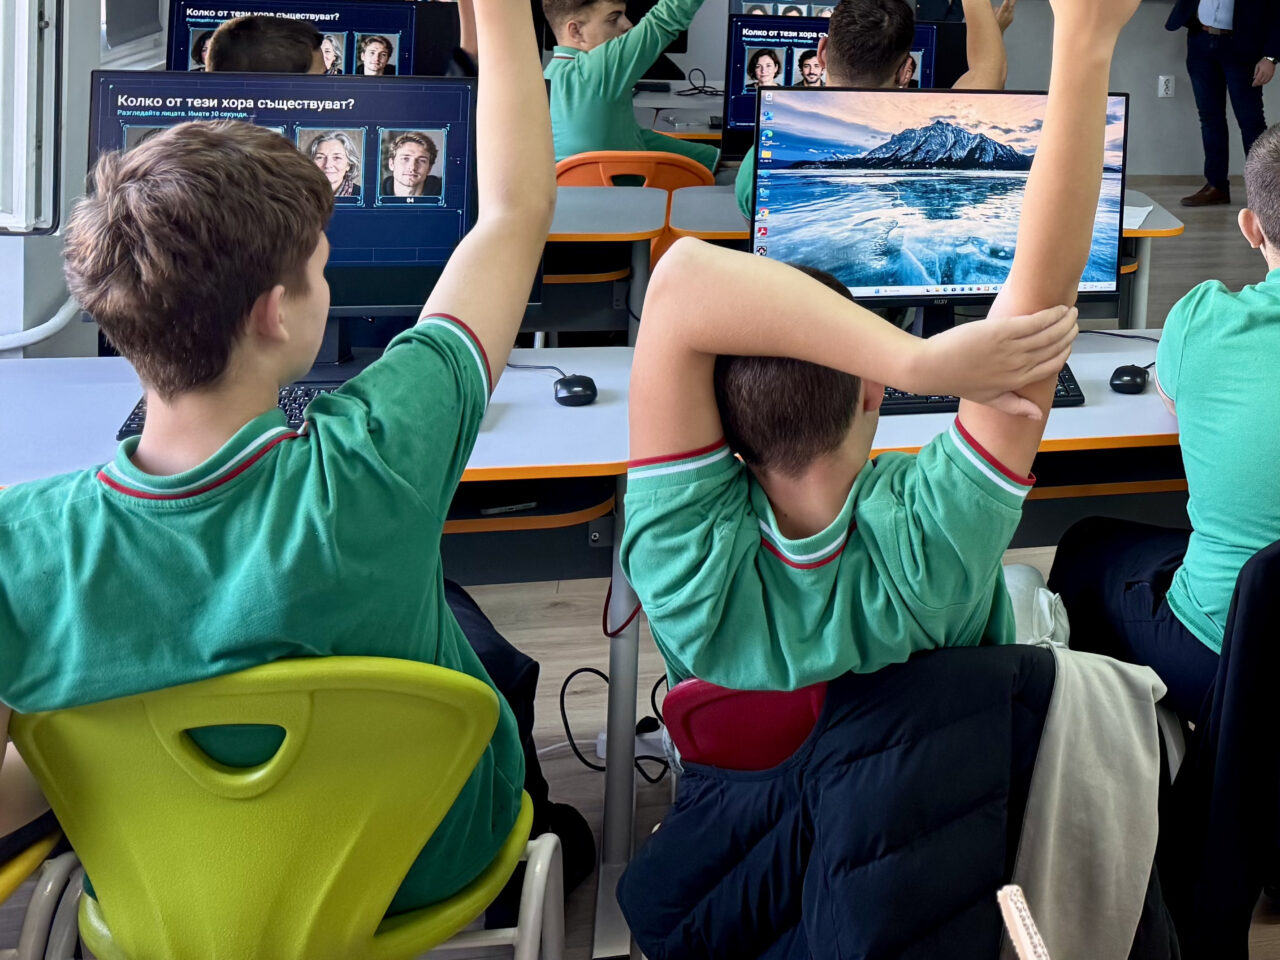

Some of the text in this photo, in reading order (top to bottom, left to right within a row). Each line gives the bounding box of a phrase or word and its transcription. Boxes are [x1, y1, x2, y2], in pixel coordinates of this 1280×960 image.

[186, 8, 216, 17] Колко
[230, 10, 251, 18] тези
[276, 12, 340, 21] съществуват?
[742, 28, 768, 36] Колко
[798, 31, 817, 39] хора
[117, 95, 355, 112] Колко от тези хора съществуват?
[117, 109, 160, 117] Разгледайте
